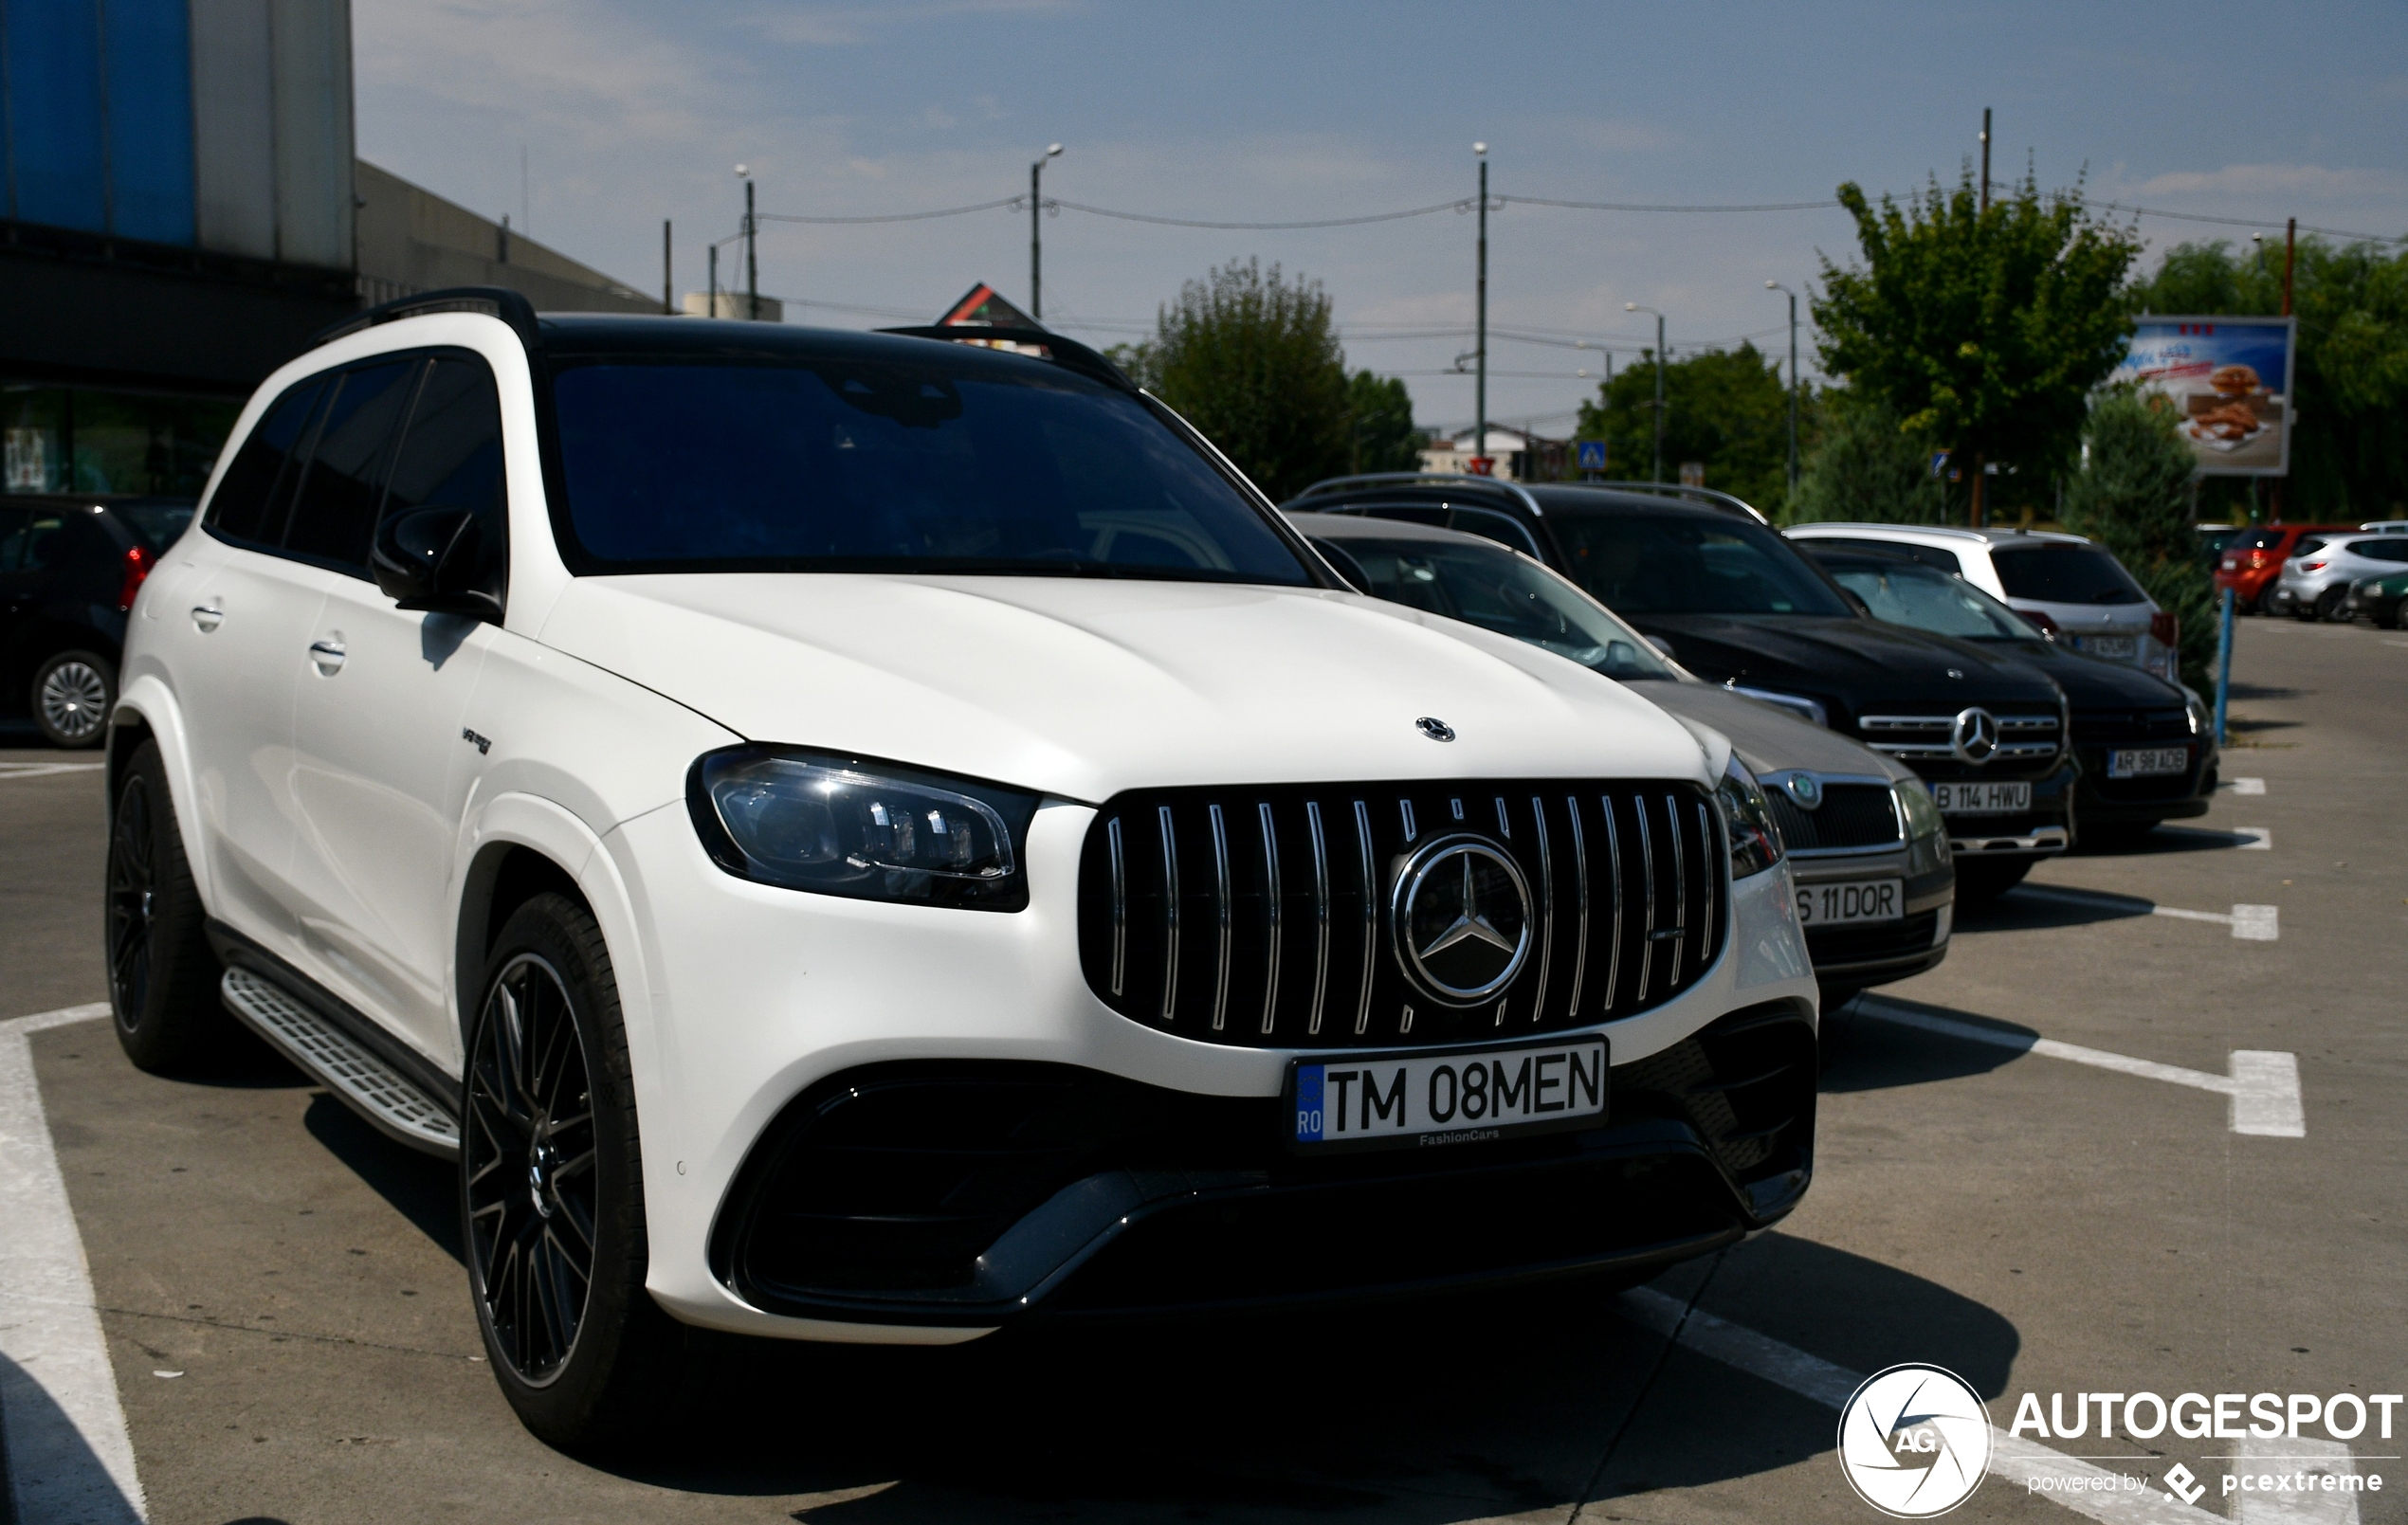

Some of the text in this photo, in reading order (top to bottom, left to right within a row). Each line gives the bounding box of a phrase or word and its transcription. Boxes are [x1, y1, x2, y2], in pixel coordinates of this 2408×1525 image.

[2116, 753, 2135, 772] AR
[1937, 785, 2028, 808] B 114 HWU
[1298, 1049, 1600, 1134] RO TM 08MEN
[1419, 1128, 1500, 1146] FashionCars
